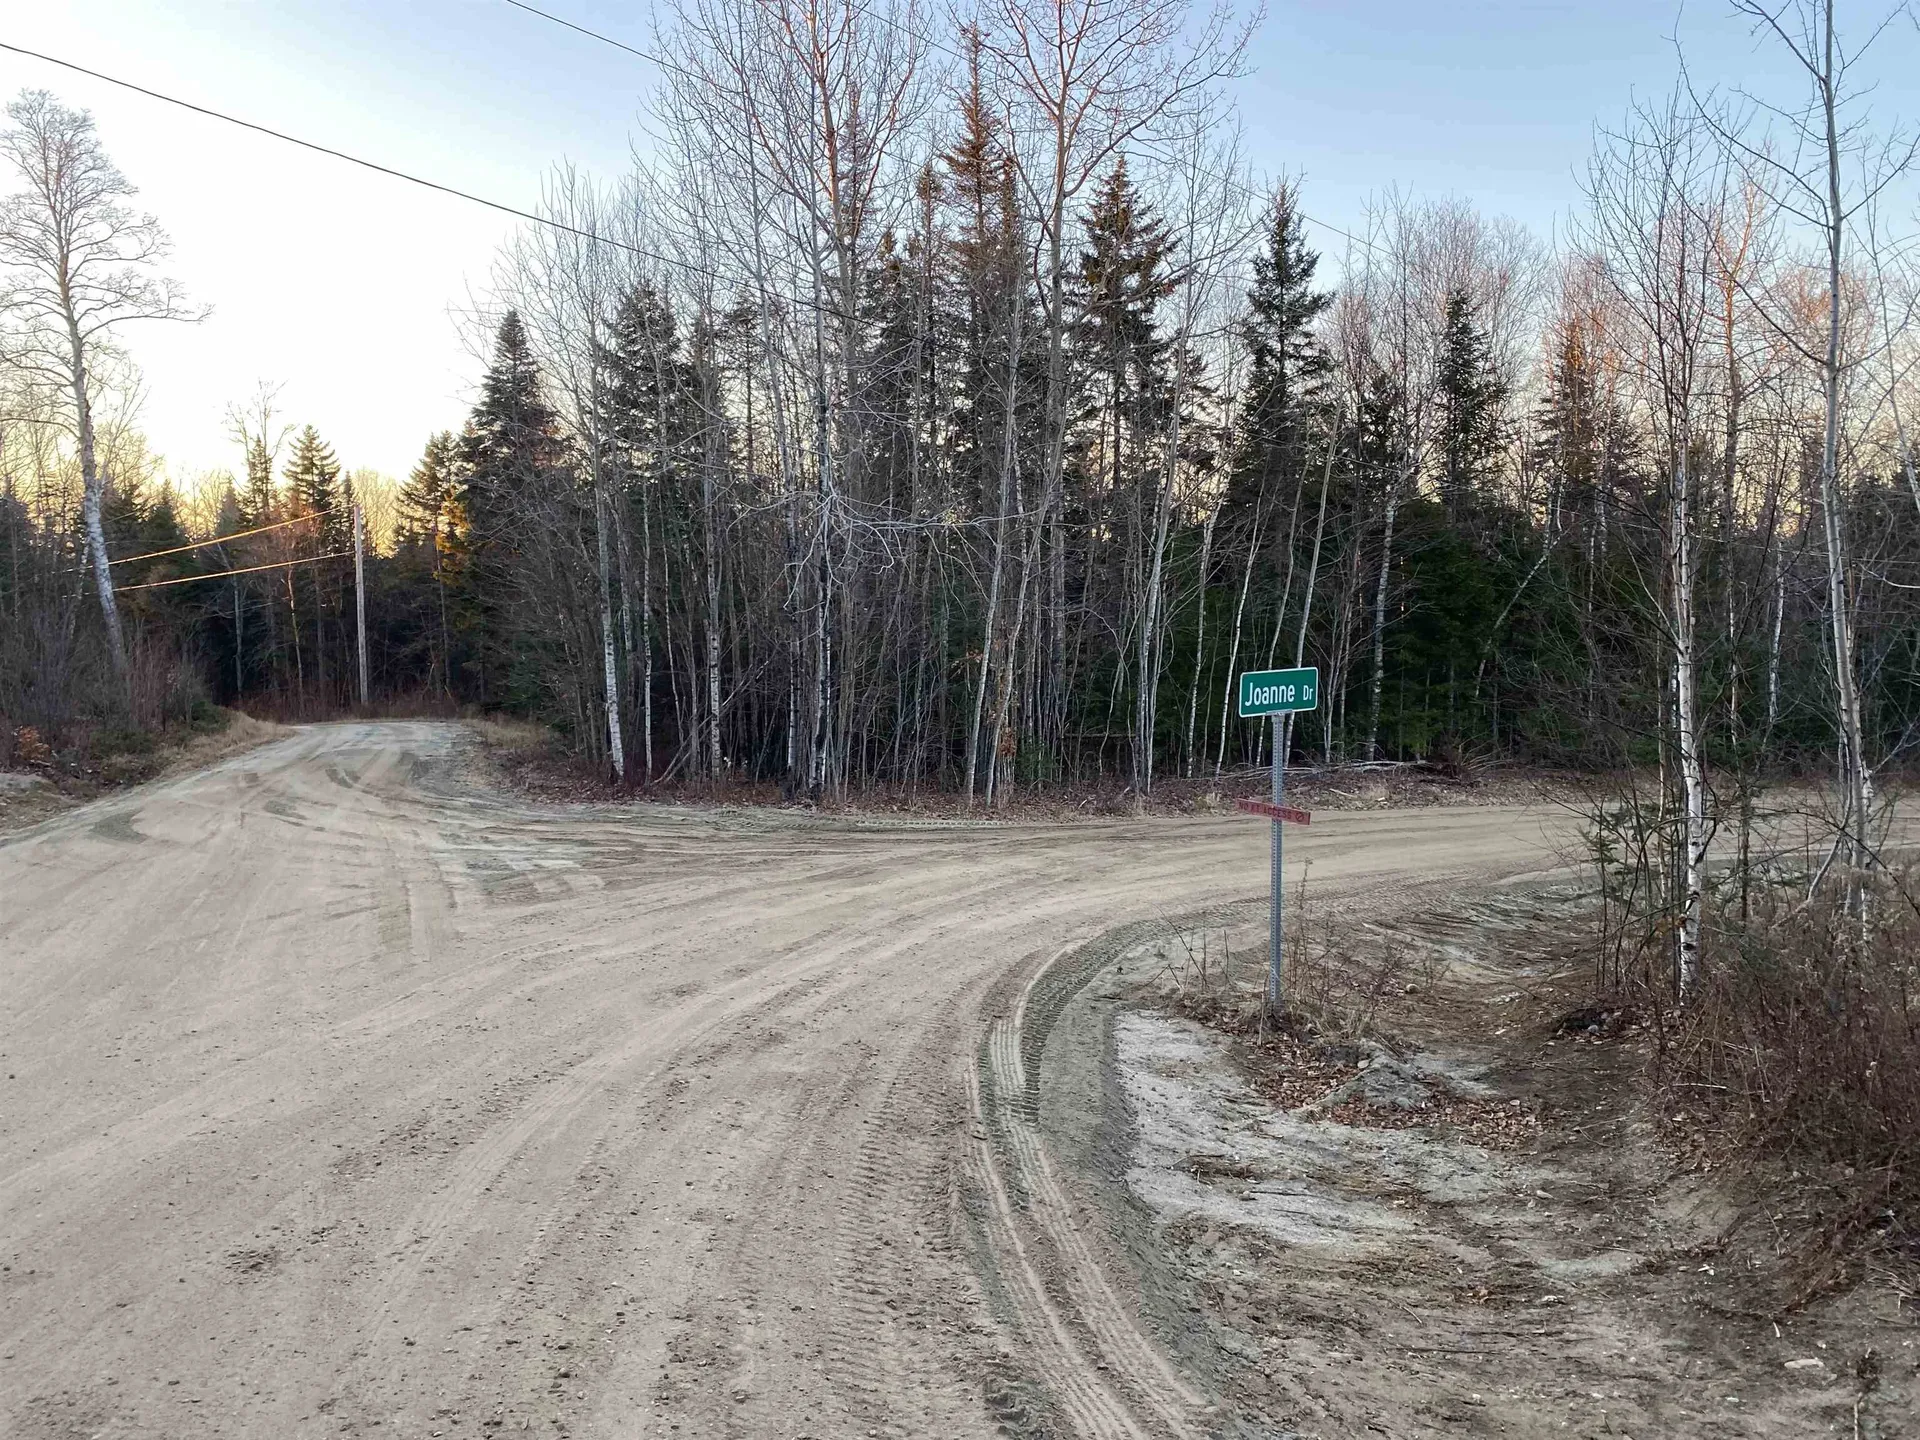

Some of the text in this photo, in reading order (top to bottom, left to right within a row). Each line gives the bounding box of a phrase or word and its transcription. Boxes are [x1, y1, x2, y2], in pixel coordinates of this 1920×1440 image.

[1244, 682, 1314, 707] Joanne Dr
[1238, 801, 1249, 810] NO
[1263, 806, 1292, 820] ACCESS
